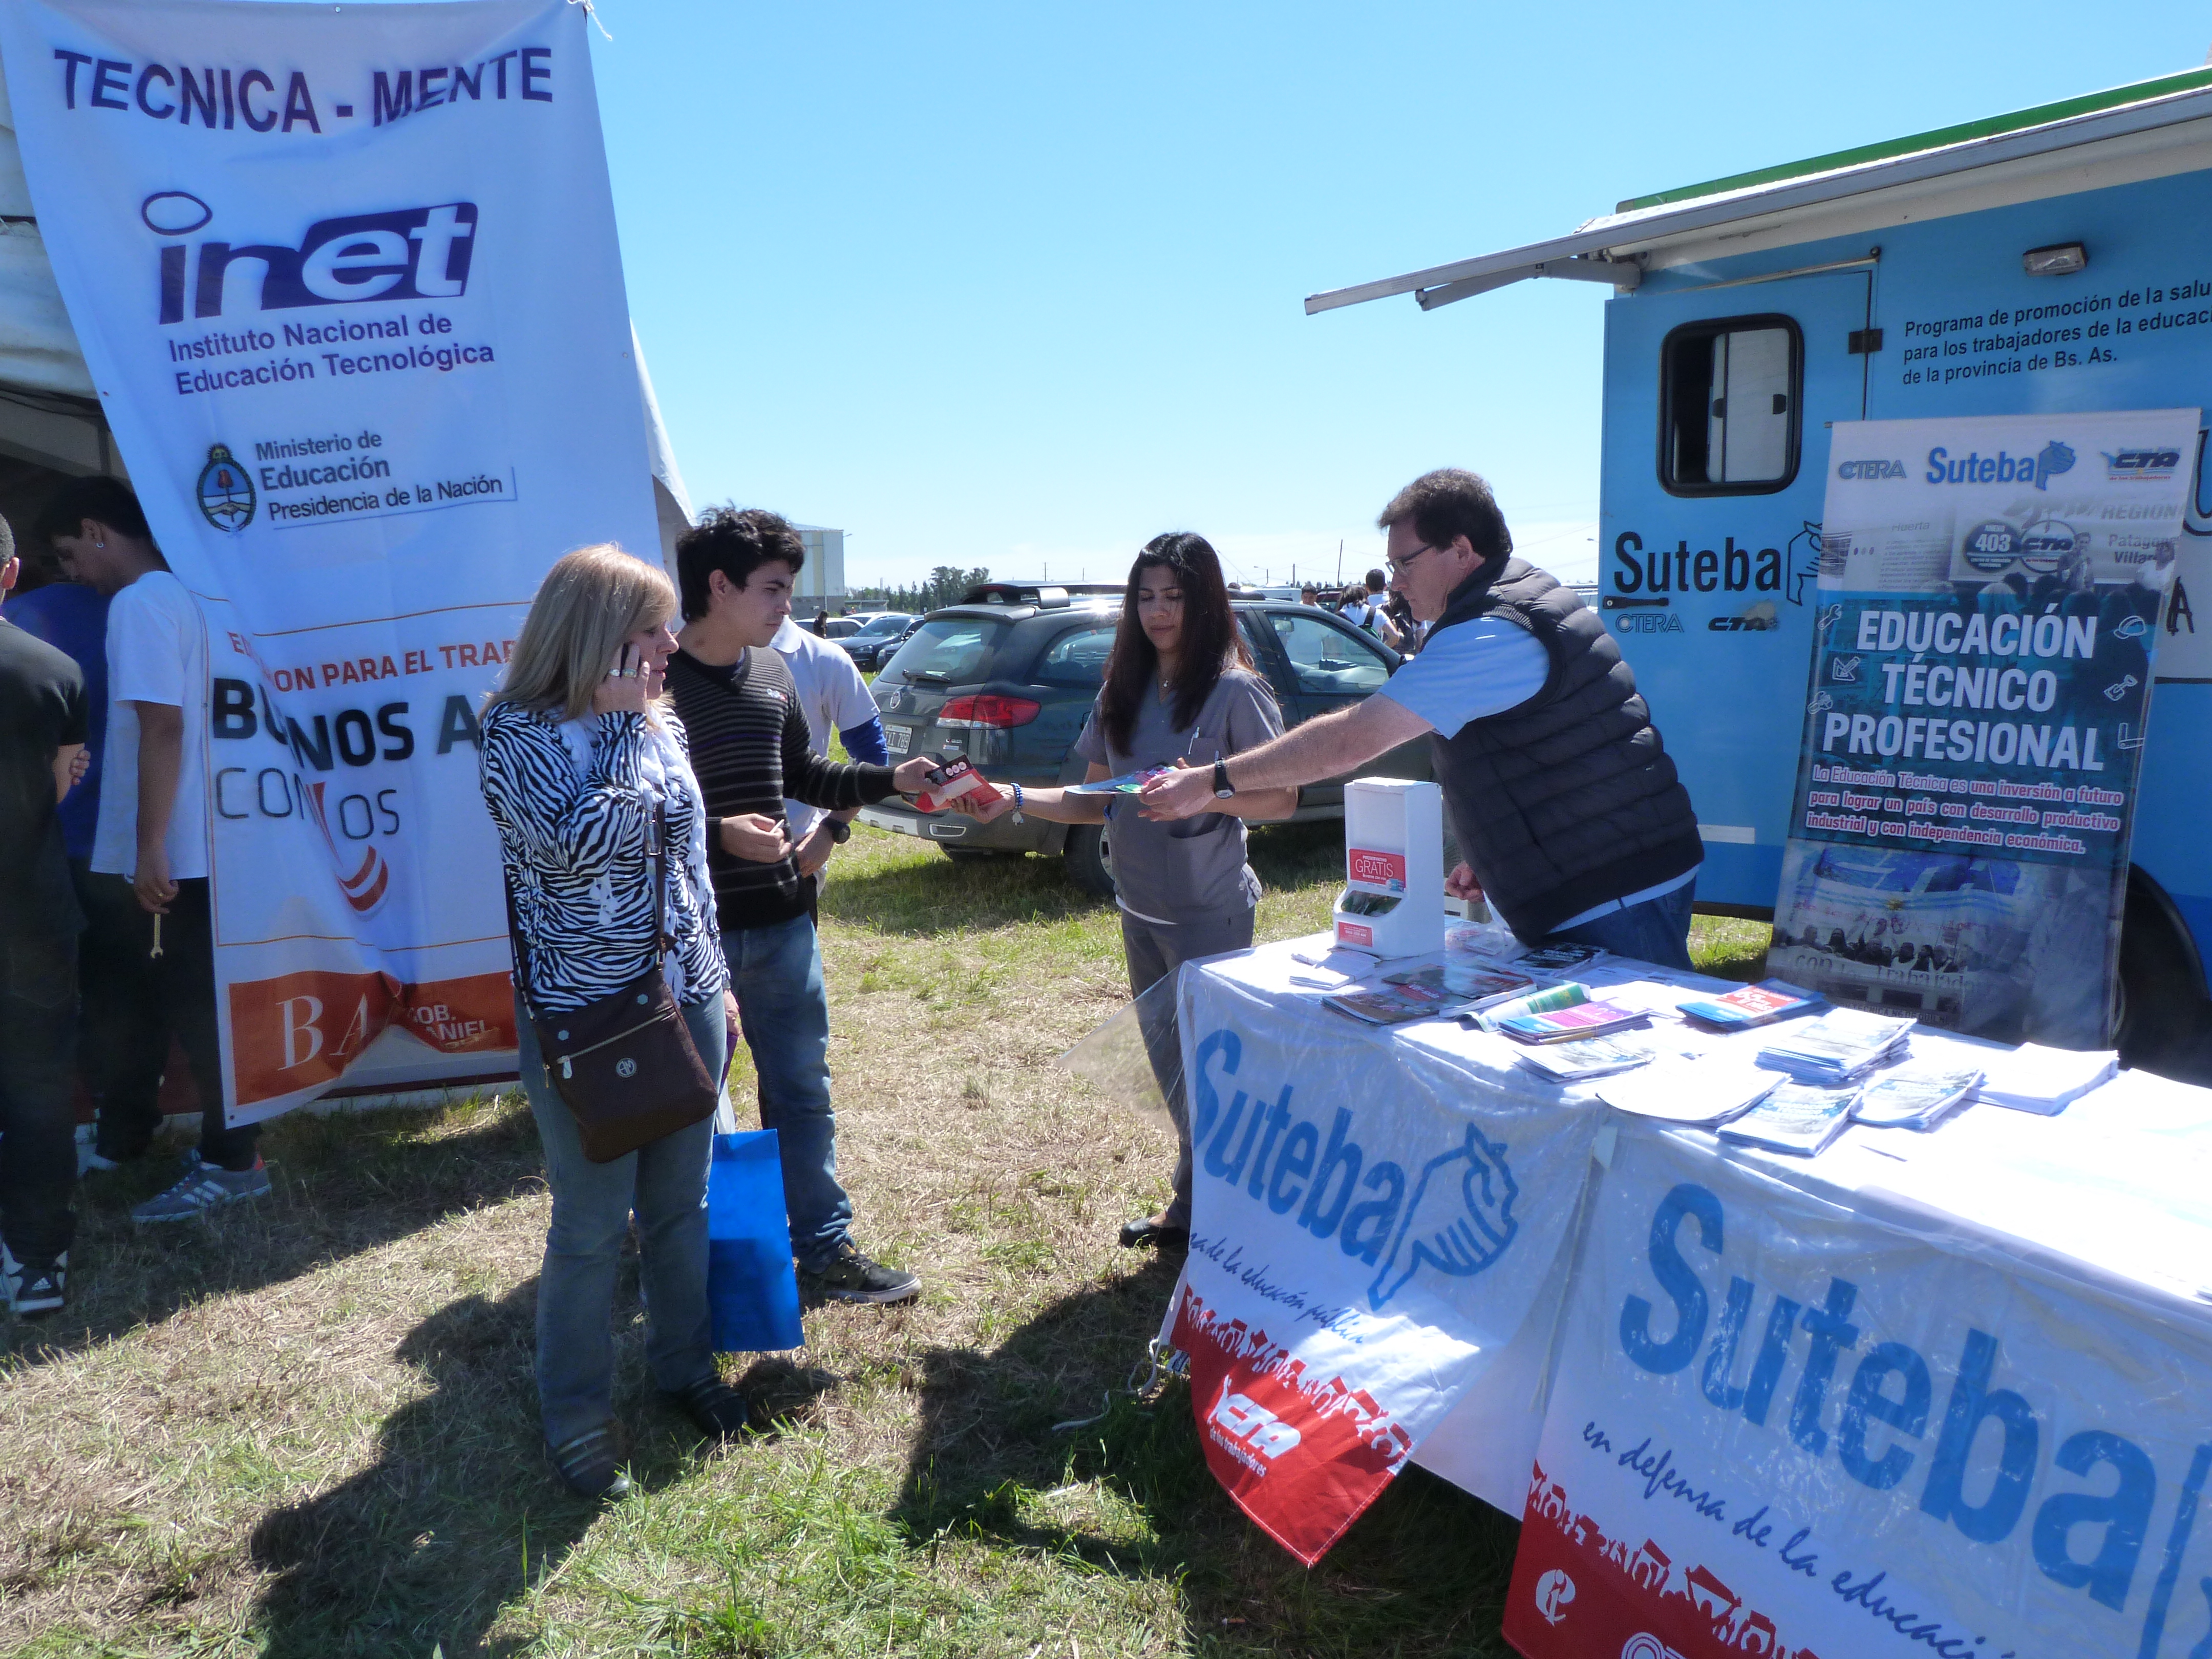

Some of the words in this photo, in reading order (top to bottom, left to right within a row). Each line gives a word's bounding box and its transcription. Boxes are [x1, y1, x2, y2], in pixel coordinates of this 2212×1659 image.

[54, 49, 322, 134] TECNICA
[373, 48, 553, 127] MENTE
[142, 191, 478, 325] inet
[1905, 313, 1983, 338] Programa
[1989, 310, 2008, 327] de
[2014, 295, 2111, 326] promoción
[2118, 290, 2140, 308] de
[2146, 287, 2162, 305] la
[169, 328, 275, 361] Instituto
[284, 314, 409, 347] Nacional
[418, 313, 452, 334] de
[1904, 342, 1938, 365] para
[1944, 340, 1967, 356] los
[1973, 328, 2081, 352] trabajadores
[2088, 321, 2110, 338] de
[2116, 318, 2132, 335] la
[176, 357, 315, 395] Educación
[322, 343, 495, 376] Tecnológica
[1903, 368, 1921, 385] de
[1927, 367, 1940, 382] la
[1946, 357, 2021, 384] provincia
[2028, 354, 2048, 371] de
[2054, 351, 2082, 368] Bs.
[2088, 346, 2117, 364] As.
[256, 434, 352, 461] Ministerio
[357, 430, 382, 449] de
[1838, 459, 1907, 480] CTERA
[1926, 446, 2034, 484] Suteba
[261, 456, 390, 491] Educación
[268, 491, 379, 521] Presidencia
[385, 487, 410, 507] de
[416, 484, 433, 503] la
[438, 474, 502, 500] Nación
[1892, 522, 1930, 531] Huerta
[1975, 534, 2011, 552] 403
[1614, 531, 1781, 593] Suteba
[1615, 613, 1684, 633] CTERA
[1857, 603, 2097, 659] EDUCACIÓN
[322, 655, 399, 687] PARA
[403, 650, 434, 675] EL
[1881, 653, 2057, 712] TÉCNICO
[212, 677, 415, 771] BUNOS
[1822, 712, 2104, 772] PROFESIONAL
[1814, 765, 1828, 780] La
[1832, 767, 1894, 785] Educación
[1899, 772, 1948, 790] Técnica
[1951, 781, 1966, 792] es
[1971, 782, 1994, 794] una
[2000, 780, 2060, 800] inversión
[2065, 790, 2073, 800] a
[2078, 786, 2121, 804] futuro
[1808, 813, 1864, 831] industrial
[1869, 822, 1878, 835] y
[1882, 823, 1904, 835] con
[1909, 822, 2001, 844] independencia
[2007, 833, 2084, 853] económica.
[1811, 793, 1838, 805] para
[1844, 792, 1880, 810] lograr
[1886, 799, 1901, 811] un
[1907, 798, 1935, 814] país
[1942, 804, 1965, 816] con
[1972, 803, 2037, 822] desarrollo
[2044, 812, 2119, 830] productivo
[1355, 859, 1393, 877] GRATIS
[1194, 1029, 1405, 1267] Suteba
[1223, 1246, 1243, 1274] la
[1620, 1183, 2156, 1613] Suteba
[1224, 1437, 1267, 1477] trabajadores
[1583, 1421, 1611, 1453] en
[1619, 1438, 1724, 1521] defensa
[1733, 1505, 1772, 1546] de
[1779, 1527, 1818, 1577] la
